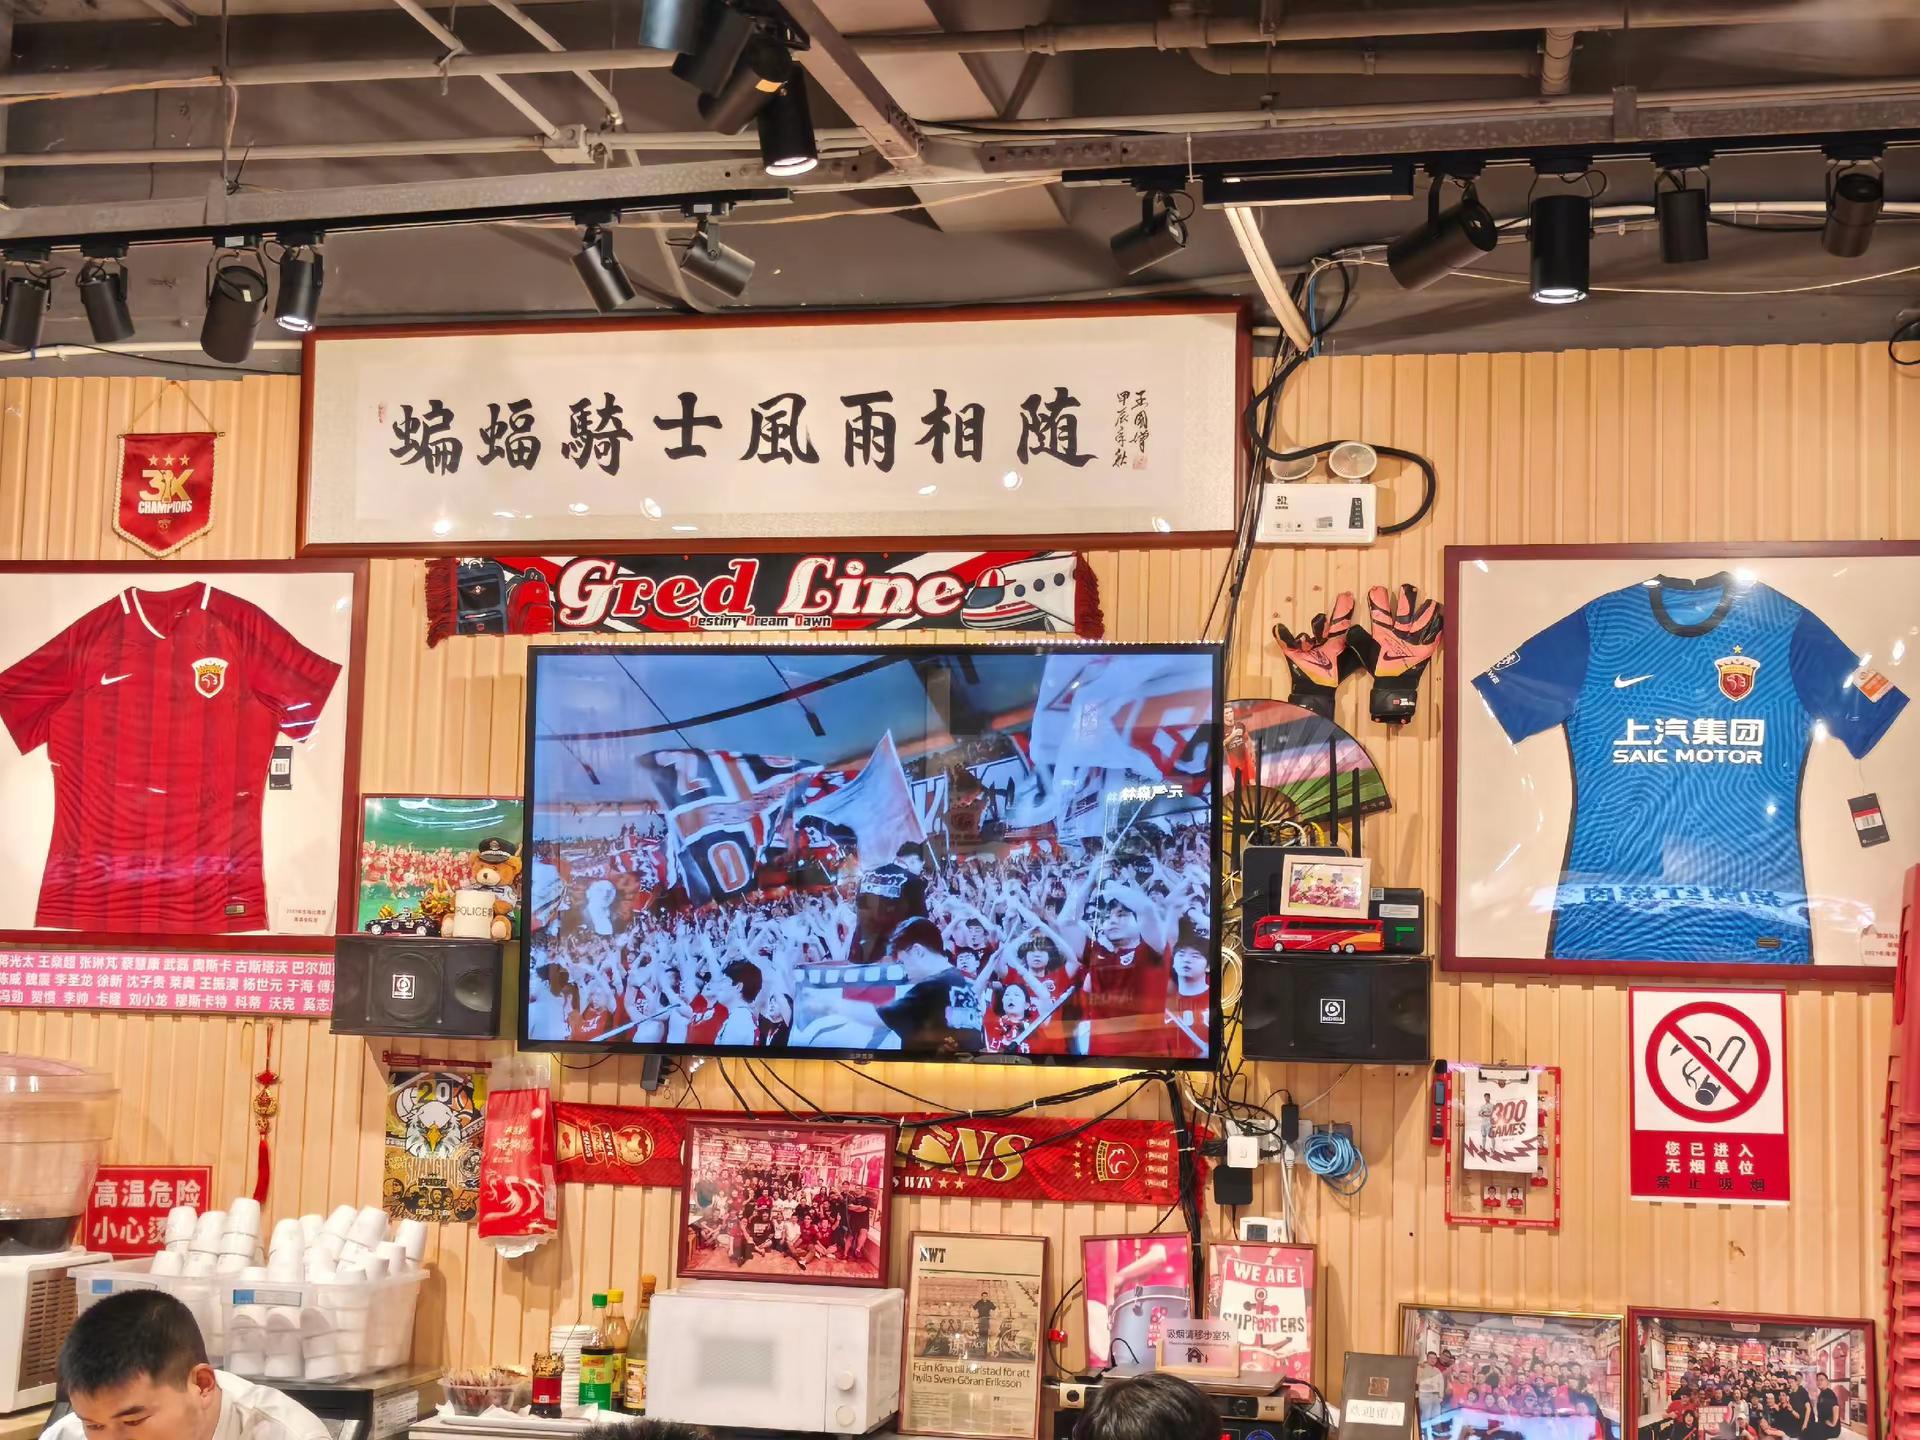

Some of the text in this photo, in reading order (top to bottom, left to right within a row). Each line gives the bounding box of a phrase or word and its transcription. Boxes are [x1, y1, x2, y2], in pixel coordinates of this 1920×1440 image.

[138, 500, 192, 515] CHAMPIONS
[559, 555, 967, 626] Gred Line
[690, 614, 831, 628] Destiny Dream Dawn
[1613, 718, 1765, 746] 上汽集团
[1613, 749, 1763, 764] SAIC MOTOR
[164, 958, 189, 972] 武磊
[192, 958, 232, 973] 奥斯卡
[236, 959, 288, 974] 古斯塔沃
[292, 961, 335, 976] 巴尔加
[97, 974, 122, 988] 徐新
[243, 978, 282, 992] 杨世元
[287, 979, 313, 993] 于海
[63, 991, 89, 1004] 李帅
[129, 993, 168, 1007] 刘小龙
[175, 994, 227, 1008] 穆斯卡特
[269, 996, 295, 1011] 沃克
[303, 997, 333, 1012] 奚志
[1488, 1122, 1526, 1138] GAMES
[1665, 1141, 1754, 1158] 您已进入
[1665, 1159, 1755, 1175] 无烟单位
[1656, 1175, 1766, 1192] 禁止吸烟
[94, 1179, 201, 1208] 高温危险
[919, 1247, 947, 1263] NWT
[1233, 1261, 1297, 1283] WE ARE
[1222, 1312, 1305, 1333] SUPPORTERS
[1167, 1328, 1231, 1341] 吸烟请移步室外
[913, 1361, 933, 1372] Från
[934, 1363, 953, 1374] Kina
[1003, 1366, 1015, 1378] för
[1017, 1369, 1031, 1378] att
[933, 1374, 985, 1386] Sven-Göran
[985, 1377, 1022, 1388] Eriksson
